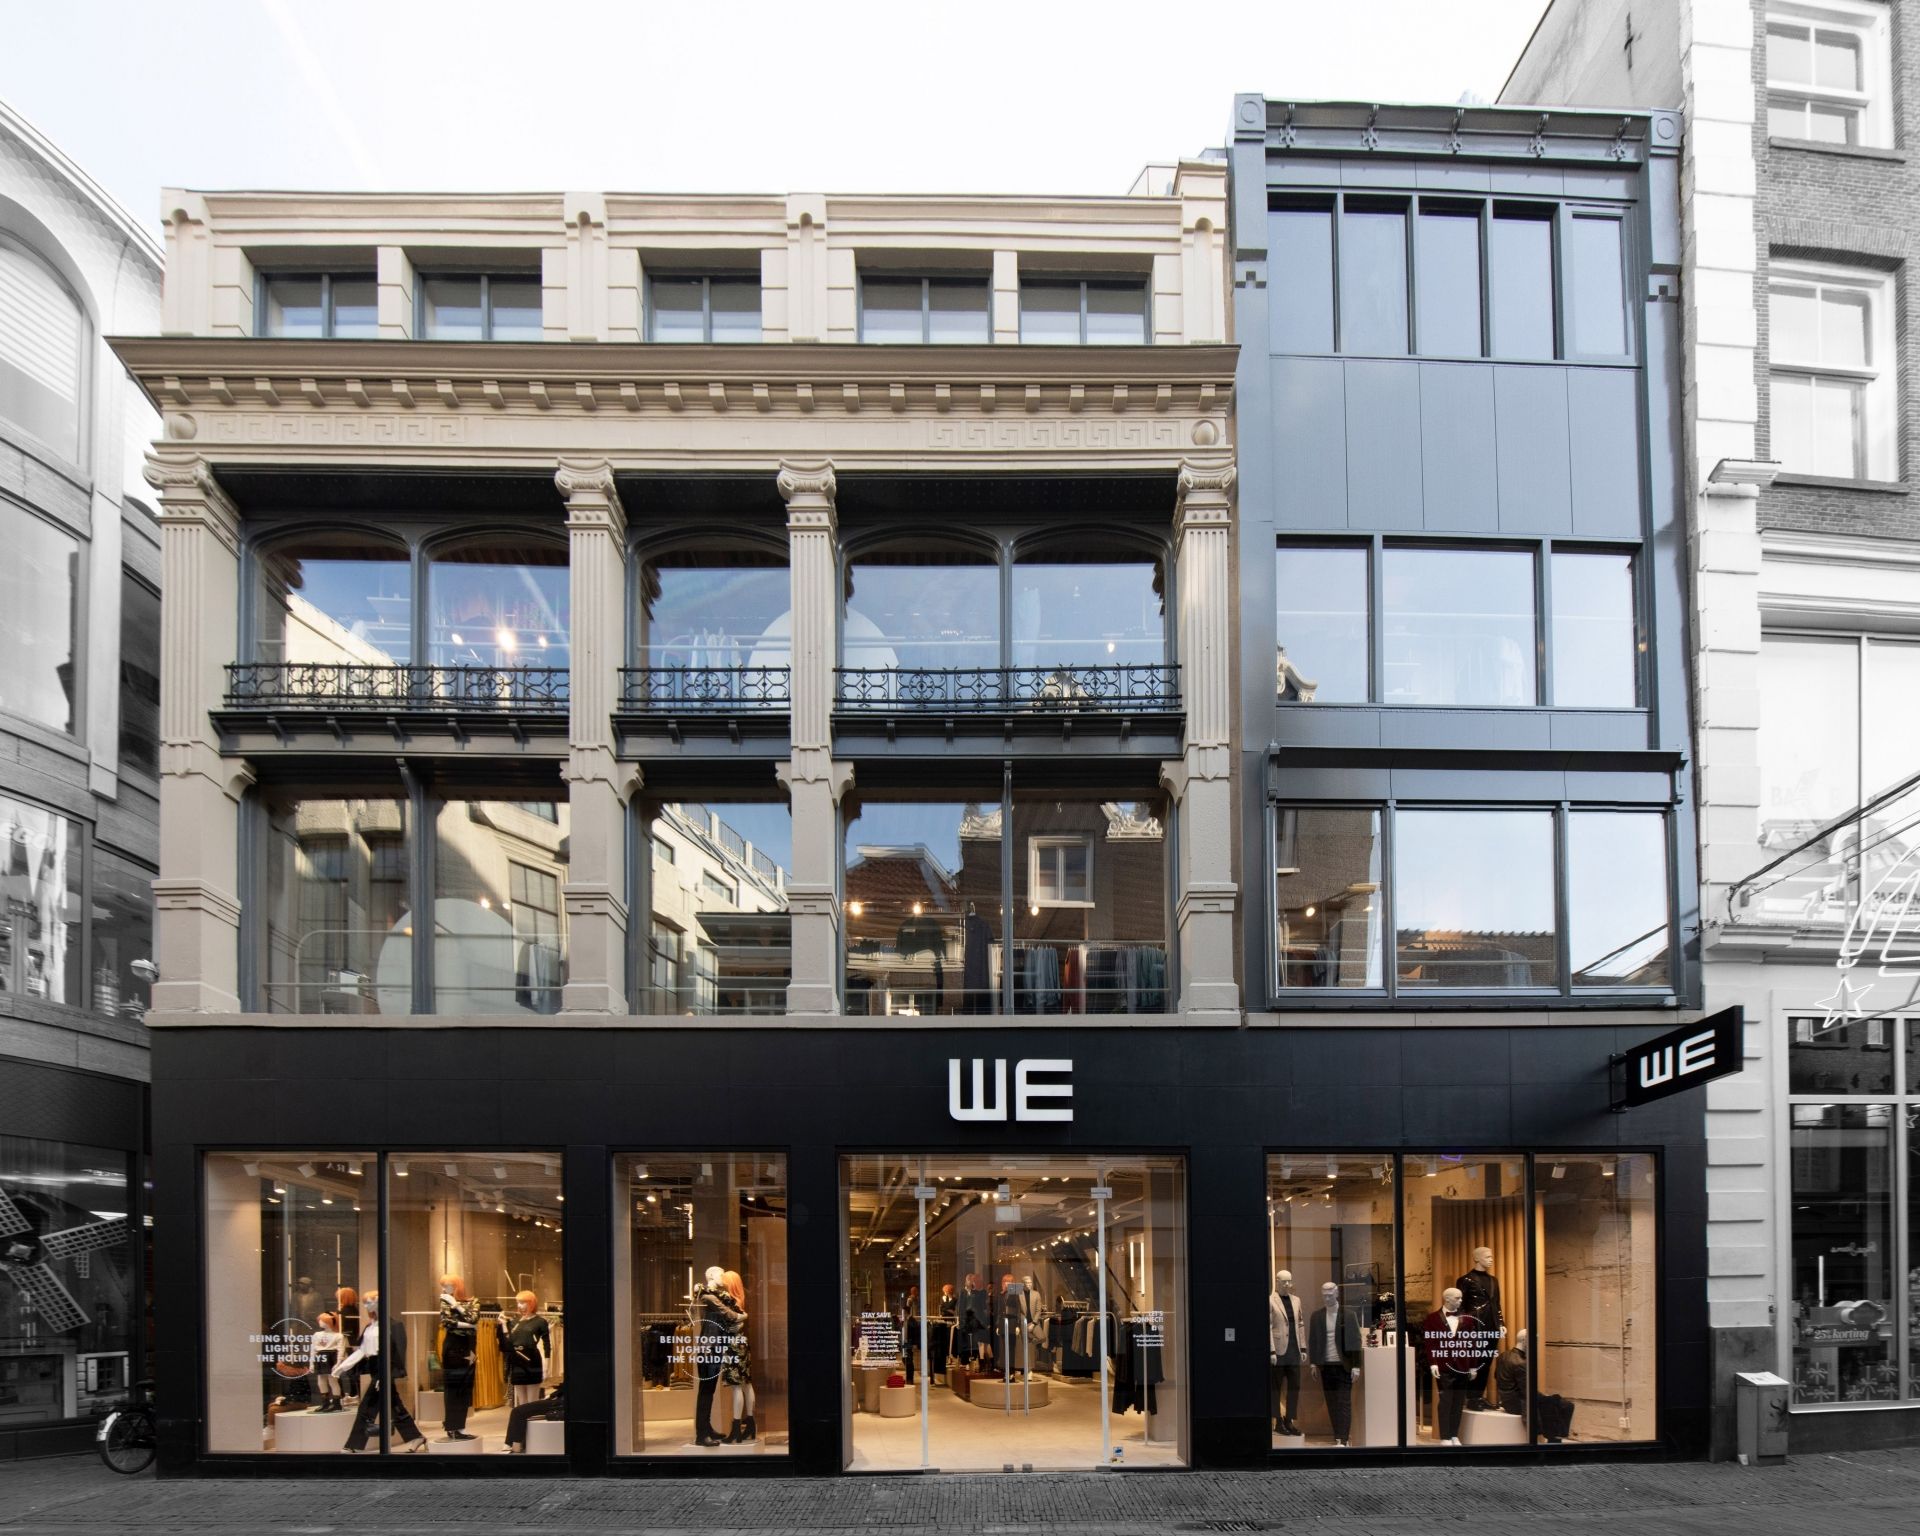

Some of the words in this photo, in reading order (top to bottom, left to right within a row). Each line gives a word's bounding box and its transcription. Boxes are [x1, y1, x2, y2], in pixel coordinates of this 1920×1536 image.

[1640, 1029, 1715, 1088] WE
[948, 1058, 1073, 1121] WE
[249, 1335, 280, 1343] BEING
[284, 1335, 330, 1343] TOGET
[1424, 1331, 1455, 1339] BEING
[1457, 1331, 1506, 1339] TOGETHER
[659, 1336, 692, 1344] BEING
[695, 1336, 747, 1344] TOGETHER
[265, 1345, 300, 1353] LIGHTS
[1431, 1350, 1449, 1358] THE
[1451, 1350, 1499, 1358] HOLIDAYS
